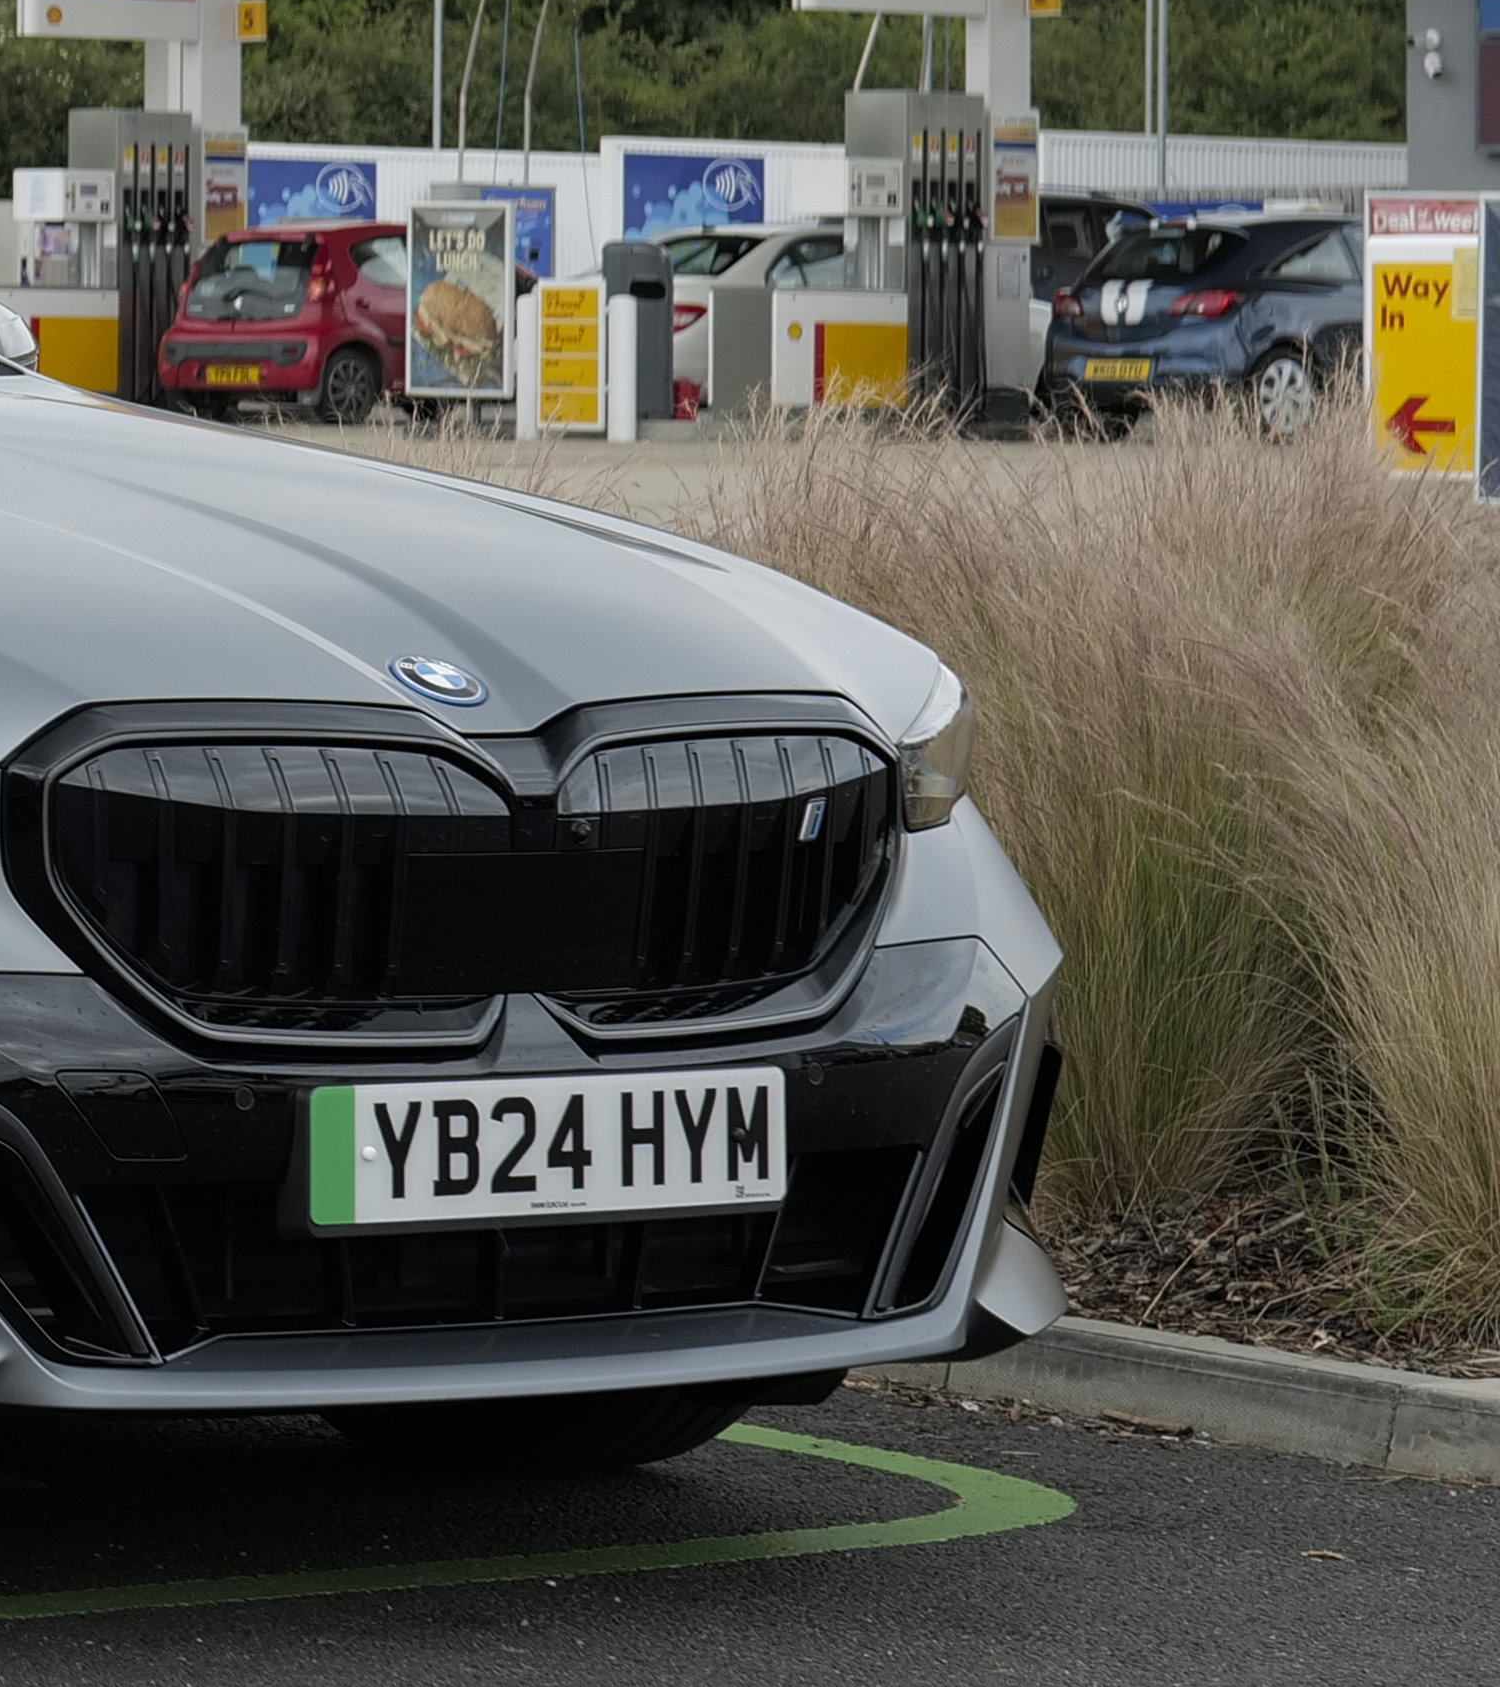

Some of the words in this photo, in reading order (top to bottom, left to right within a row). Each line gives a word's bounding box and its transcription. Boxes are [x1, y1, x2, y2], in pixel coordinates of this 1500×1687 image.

[1373, 203, 1416, 234] Deal
[428, 228, 465, 252] LET'S
[467, 228, 486, 252] DO
[435, 251, 477, 272] LUNCH
[1382, 272, 1450, 309] Way
[1381, 304, 1405, 331] In
[372, 1093, 593, 1200] YB24
[619, 1084, 771, 1188] HYM
